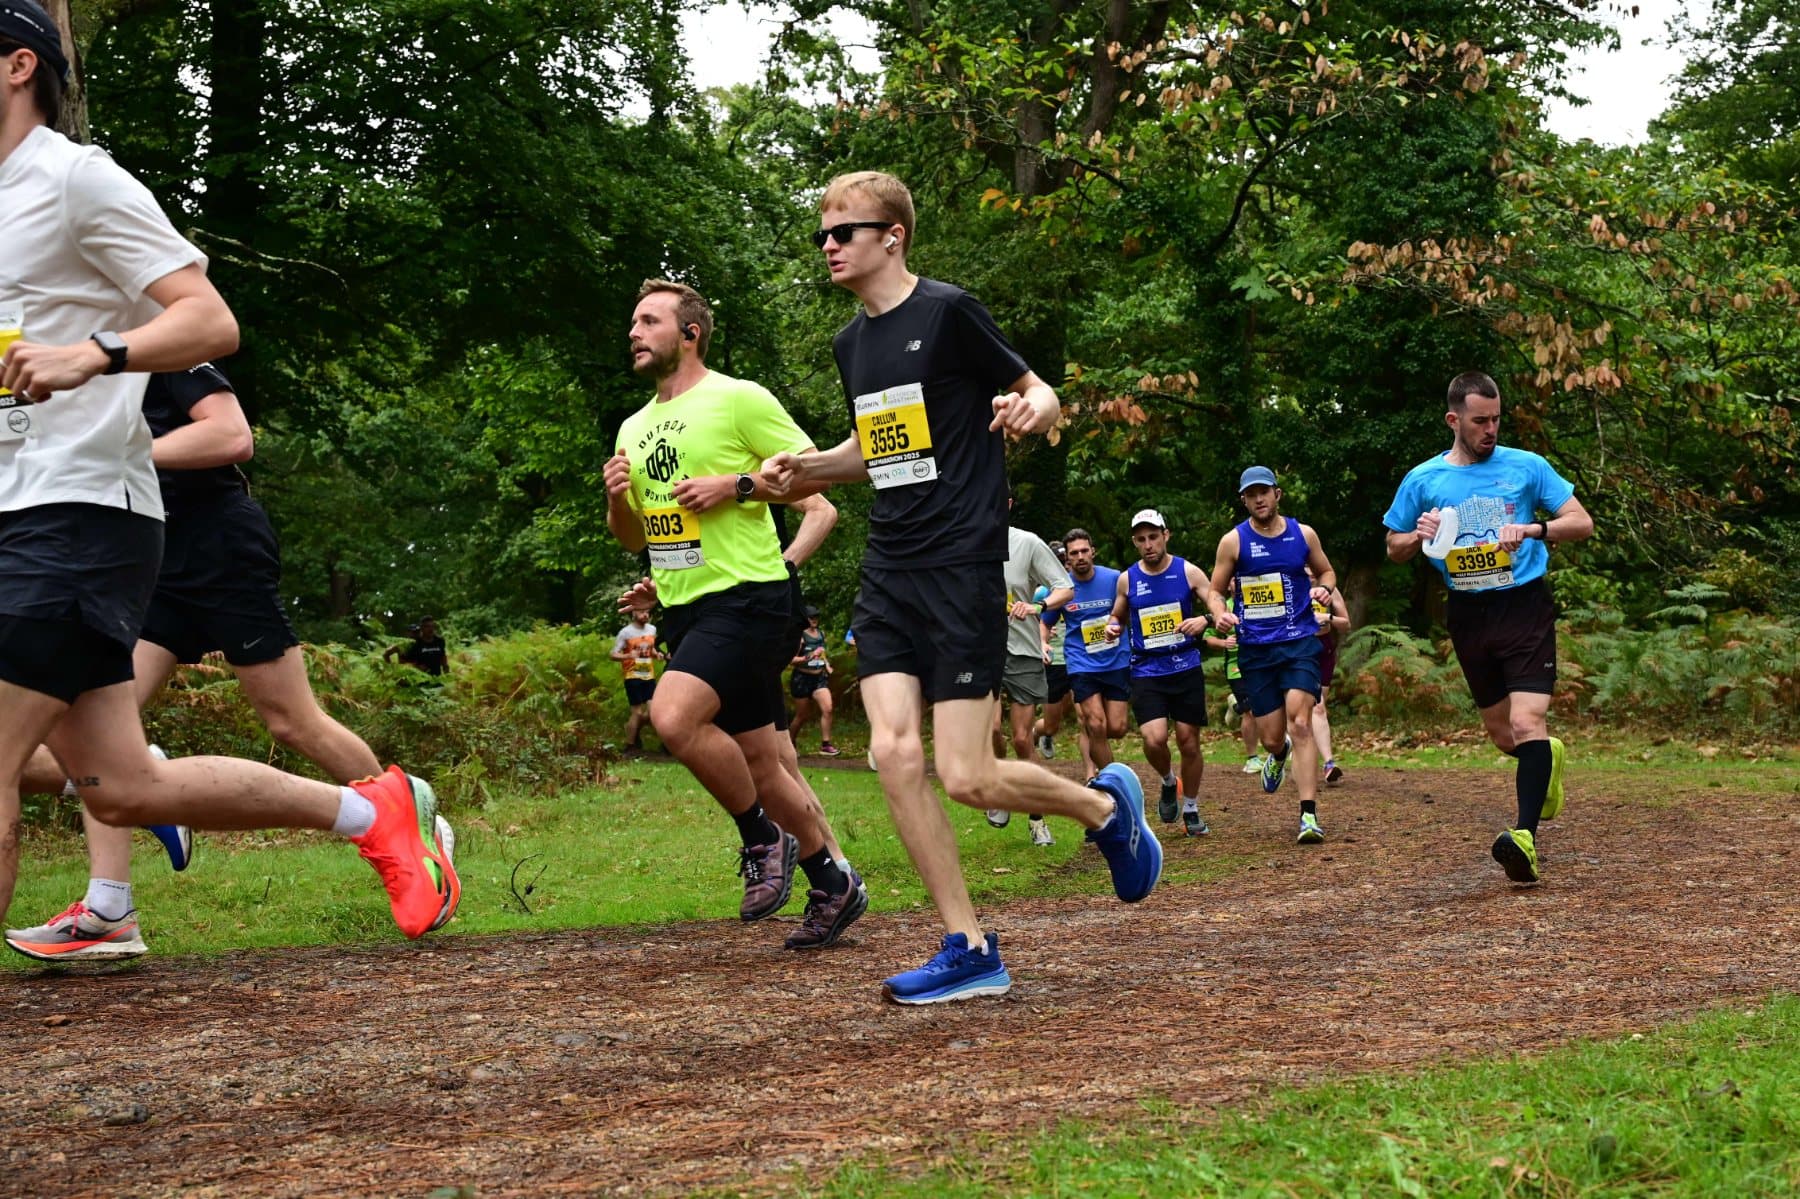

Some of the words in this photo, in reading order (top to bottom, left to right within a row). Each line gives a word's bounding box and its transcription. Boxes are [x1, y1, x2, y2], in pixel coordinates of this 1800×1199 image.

[871, 411, 897, 426] CALLUM
[638, 420, 687, 450] OUTBOX
[870, 424, 910, 455] 3555
[644, 513, 684, 537] 3603
[1456, 551, 1497, 570] 3398
[1249, 590, 1275, 603] 2054
[1149, 619, 1175, 633] 3373
